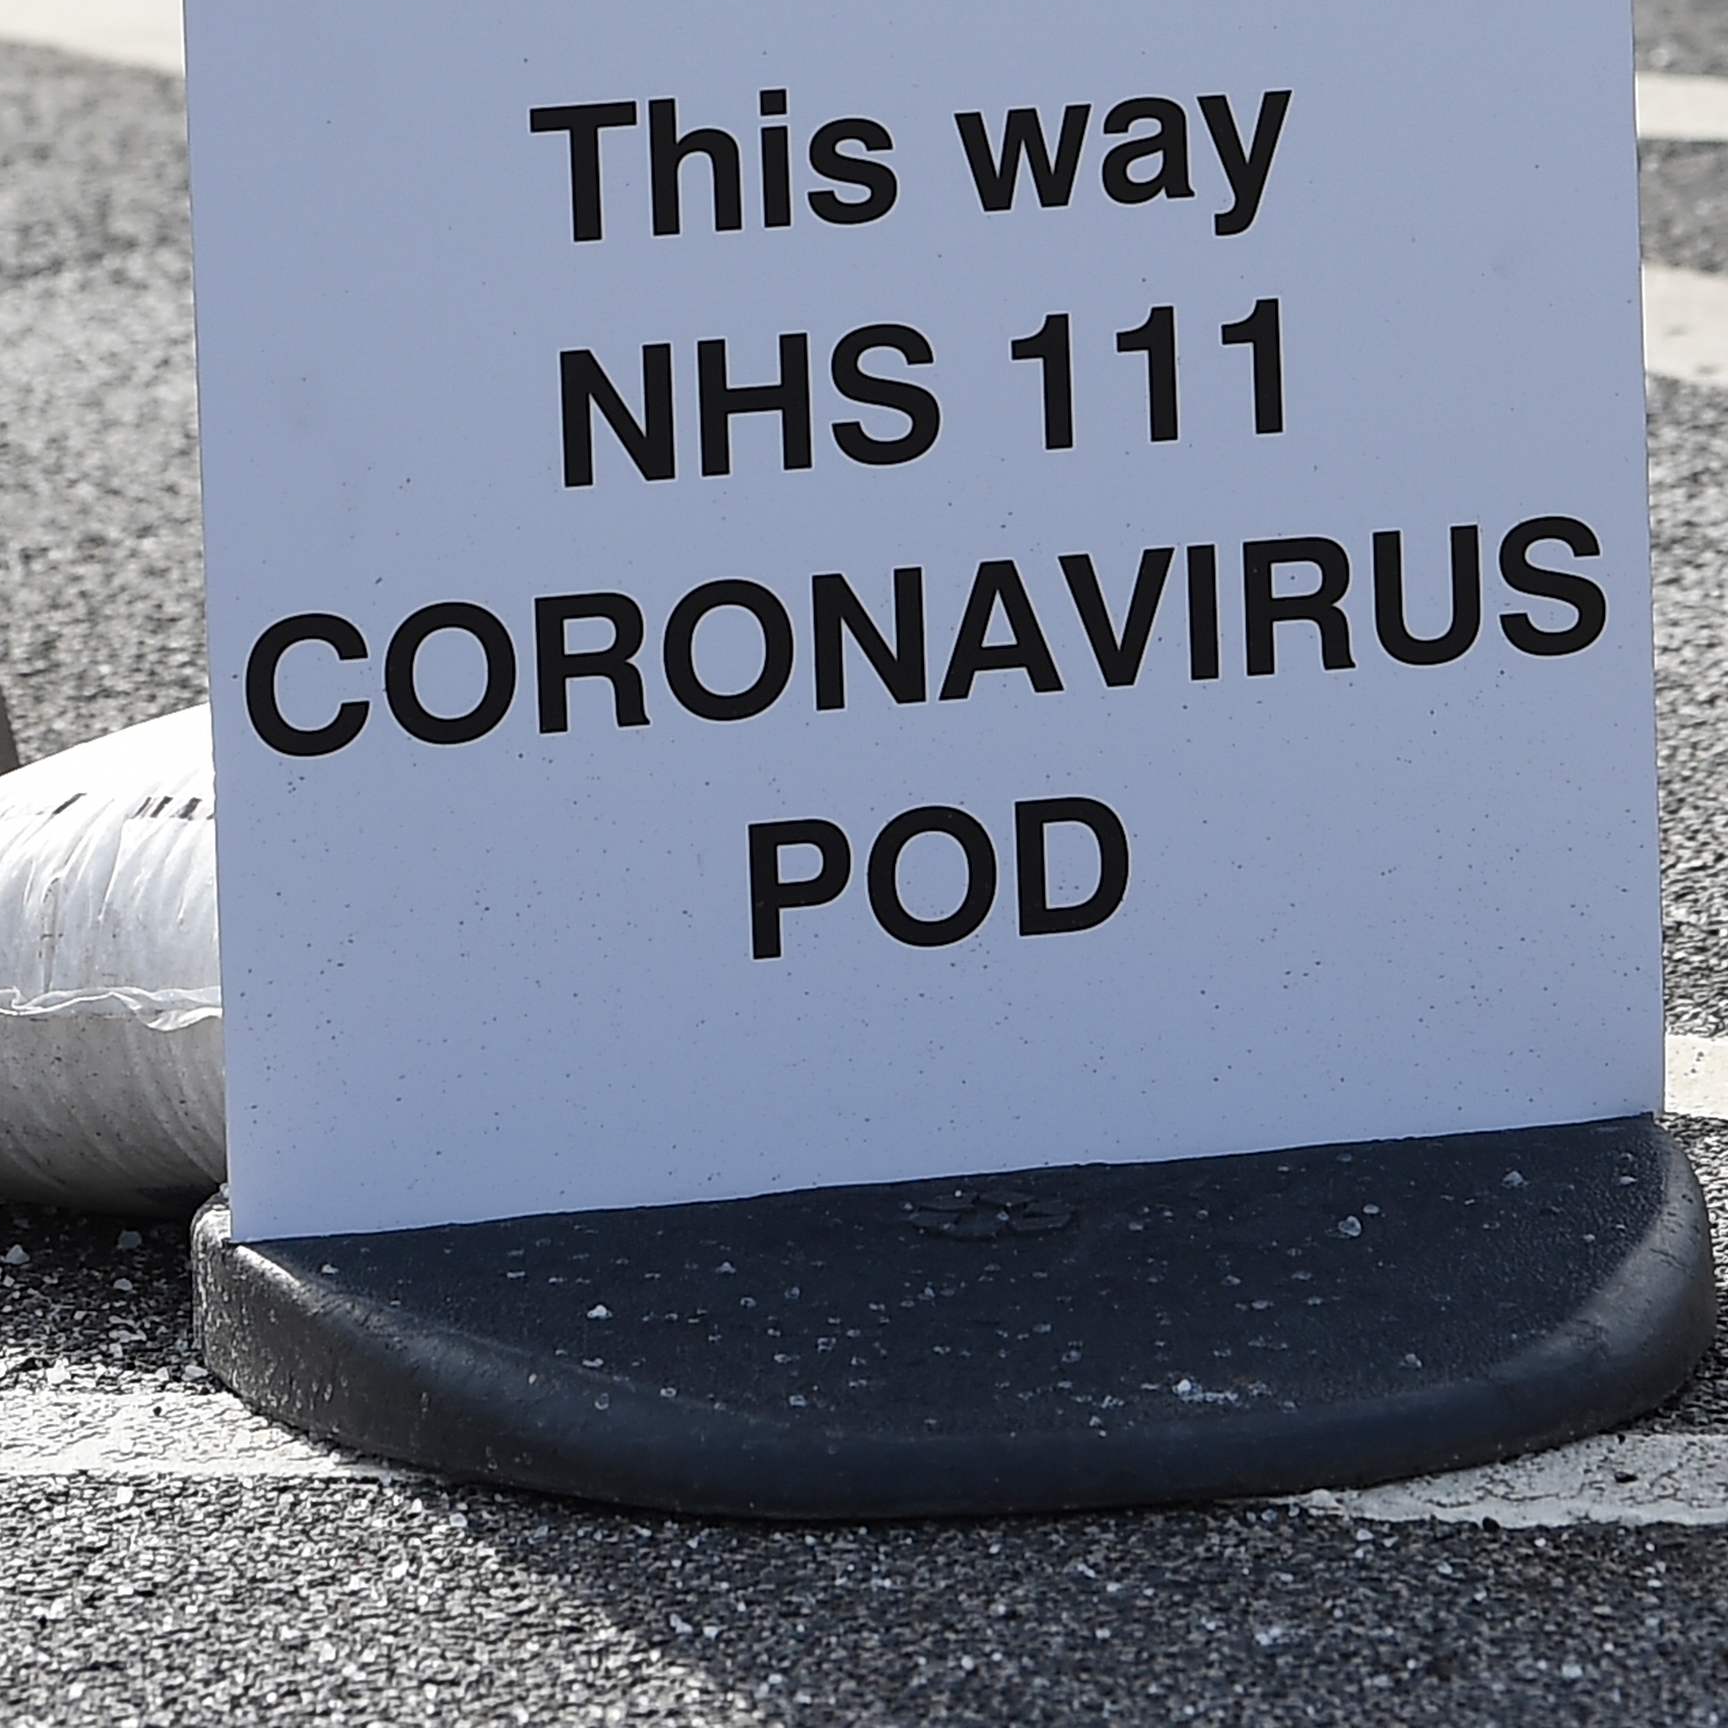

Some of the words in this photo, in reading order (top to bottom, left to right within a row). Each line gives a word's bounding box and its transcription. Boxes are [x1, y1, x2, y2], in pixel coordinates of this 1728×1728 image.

[529, 87, 899, 244] This
[953, 88, 1294, 238] way
[558, 322, 942, 489] NHS
[1009, 296, 1285, 452] 111
[244, 514, 1608, 758] CORONAVIRUS
[746, 795, 1131, 961] POD
